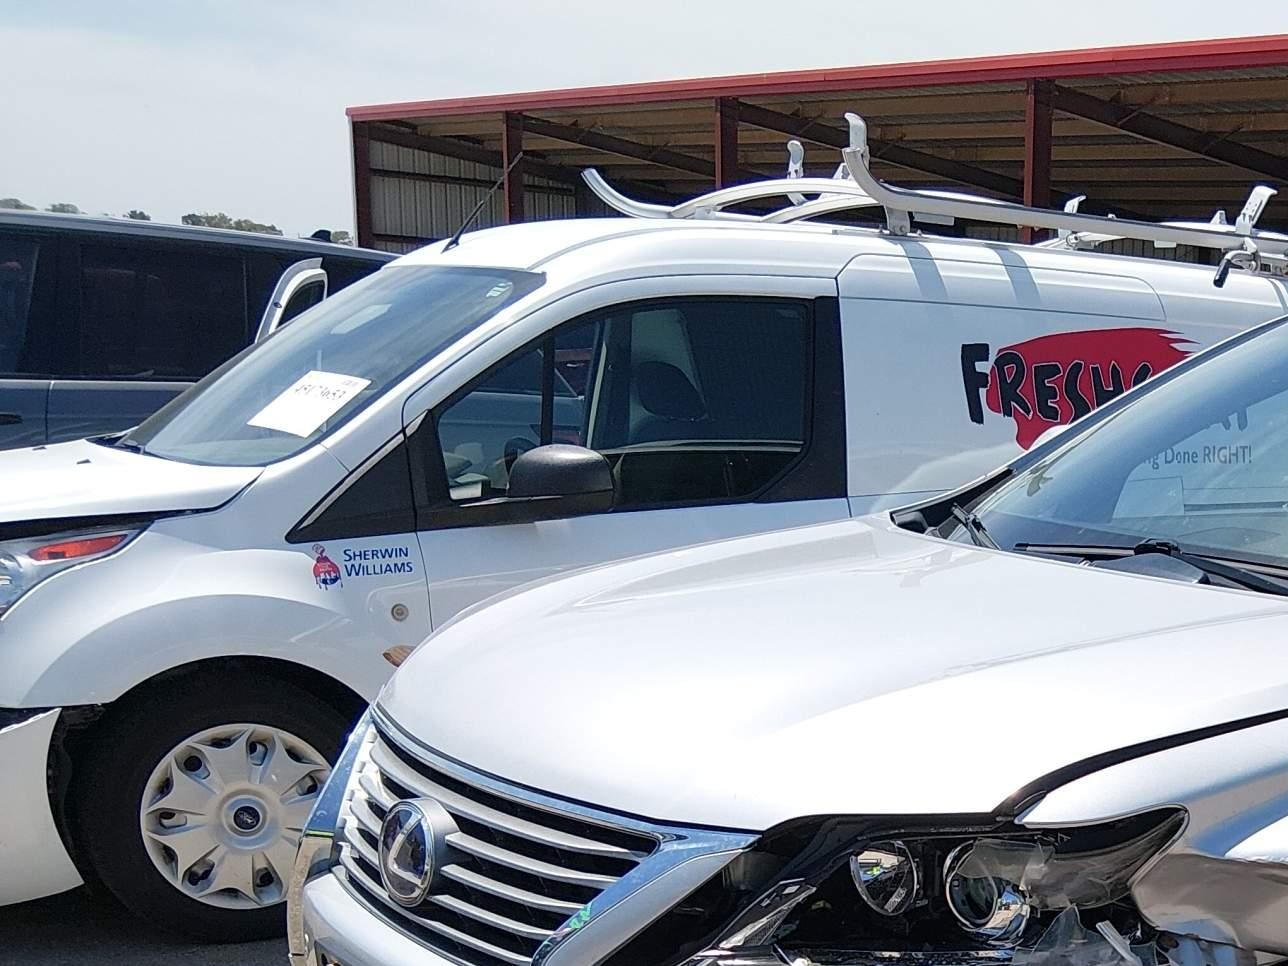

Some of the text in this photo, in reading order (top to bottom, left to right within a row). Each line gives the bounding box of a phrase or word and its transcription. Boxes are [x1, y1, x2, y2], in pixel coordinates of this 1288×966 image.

[961, 343, 1153, 425] FRESH
[1164, 448, 1199, 465] Done
[1203, 445, 1253, 465] RIGHT!
[343, 547, 409, 562] SHERWIN
[344, 562, 414, 577] WILLIAMS
